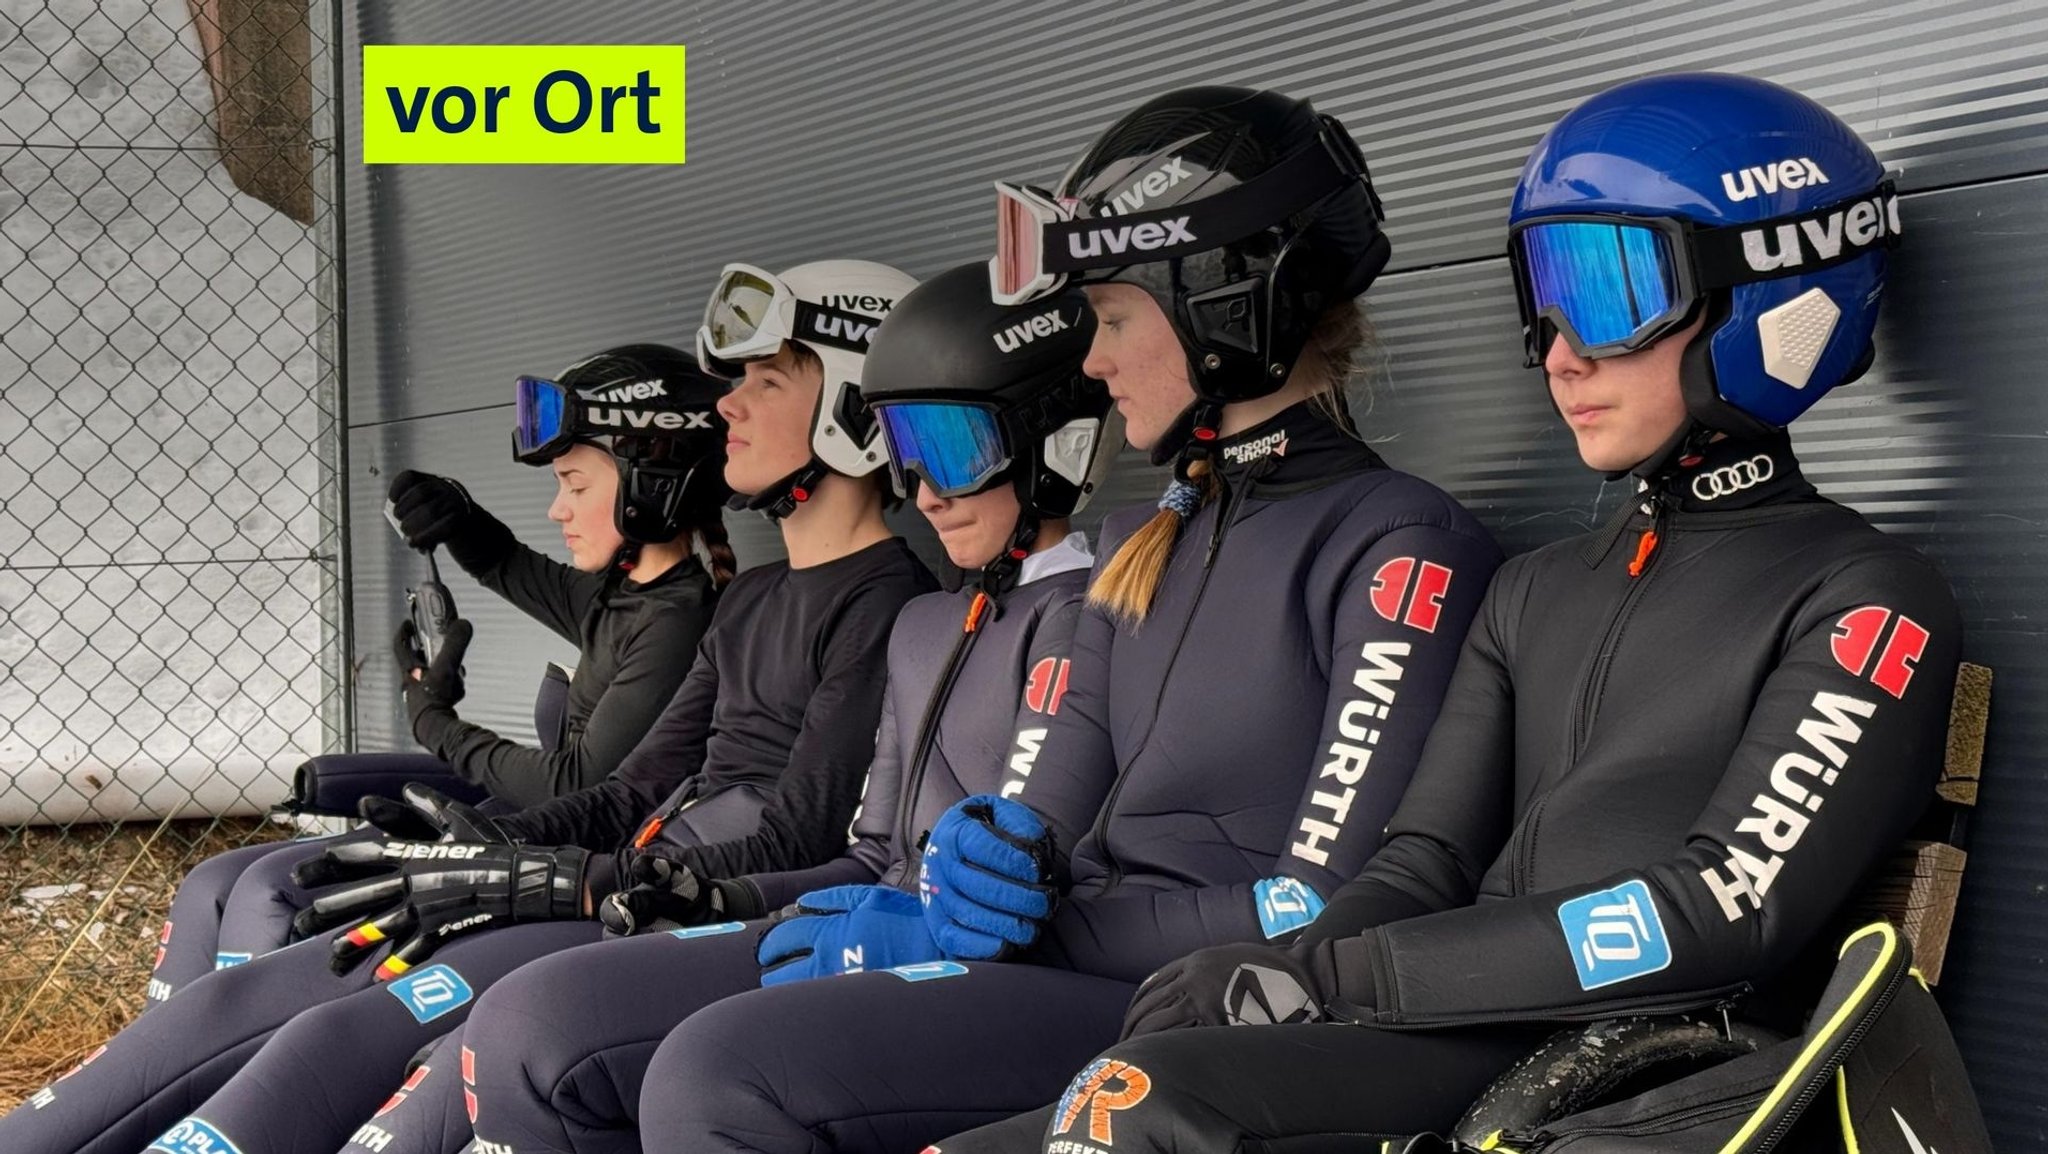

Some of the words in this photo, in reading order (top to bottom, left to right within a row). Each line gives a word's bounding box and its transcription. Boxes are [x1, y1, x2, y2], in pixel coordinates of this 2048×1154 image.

[1722, 158, 1829, 202] uvex
[1069, 216, 1198, 259] uvex
[821, 294, 893, 312] uvex
[993, 309, 1068, 353] uvex
[588, 407, 714, 429] uvex
[1223, 429, 1286, 460] personal
[1291, 642, 1411, 867] WÜRTH
[1700, 691, 1877, 923] WÜRTH
